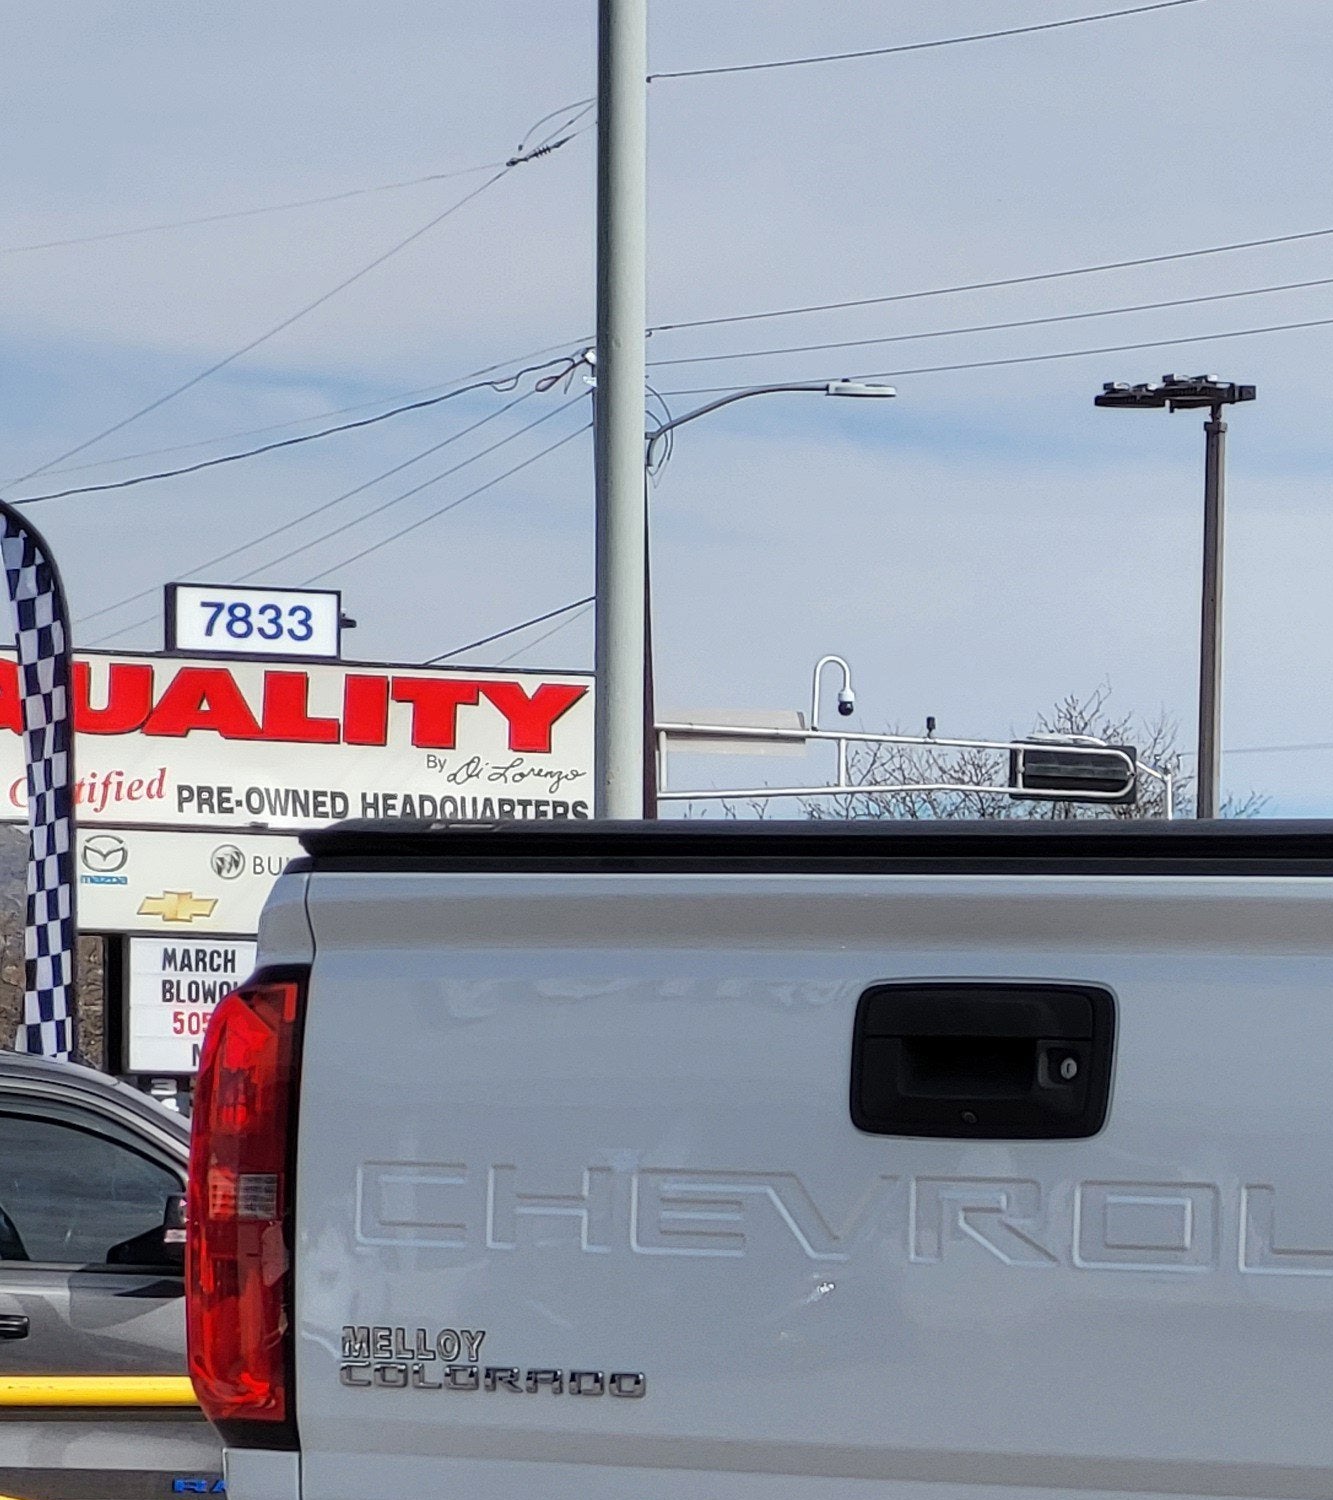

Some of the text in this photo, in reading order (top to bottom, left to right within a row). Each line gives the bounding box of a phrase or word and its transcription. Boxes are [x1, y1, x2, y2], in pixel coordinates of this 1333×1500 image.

[200, 601, 315, 642] 7833
[427, 754, 447, 772] By
[488, 757, 587, 794] Lorenzo
[9, 767, 588, 819] Ctified PRE-OWNED HEADQUARTERS
[253, 855, 291, 876] BU
[162, 947, 236, 973] MARCH
[161, 979, 238, 1004] BLOWO
[341, 1326, 486, 1361] MELLOY
[339, 1360, 647, 1398] COLORADO
